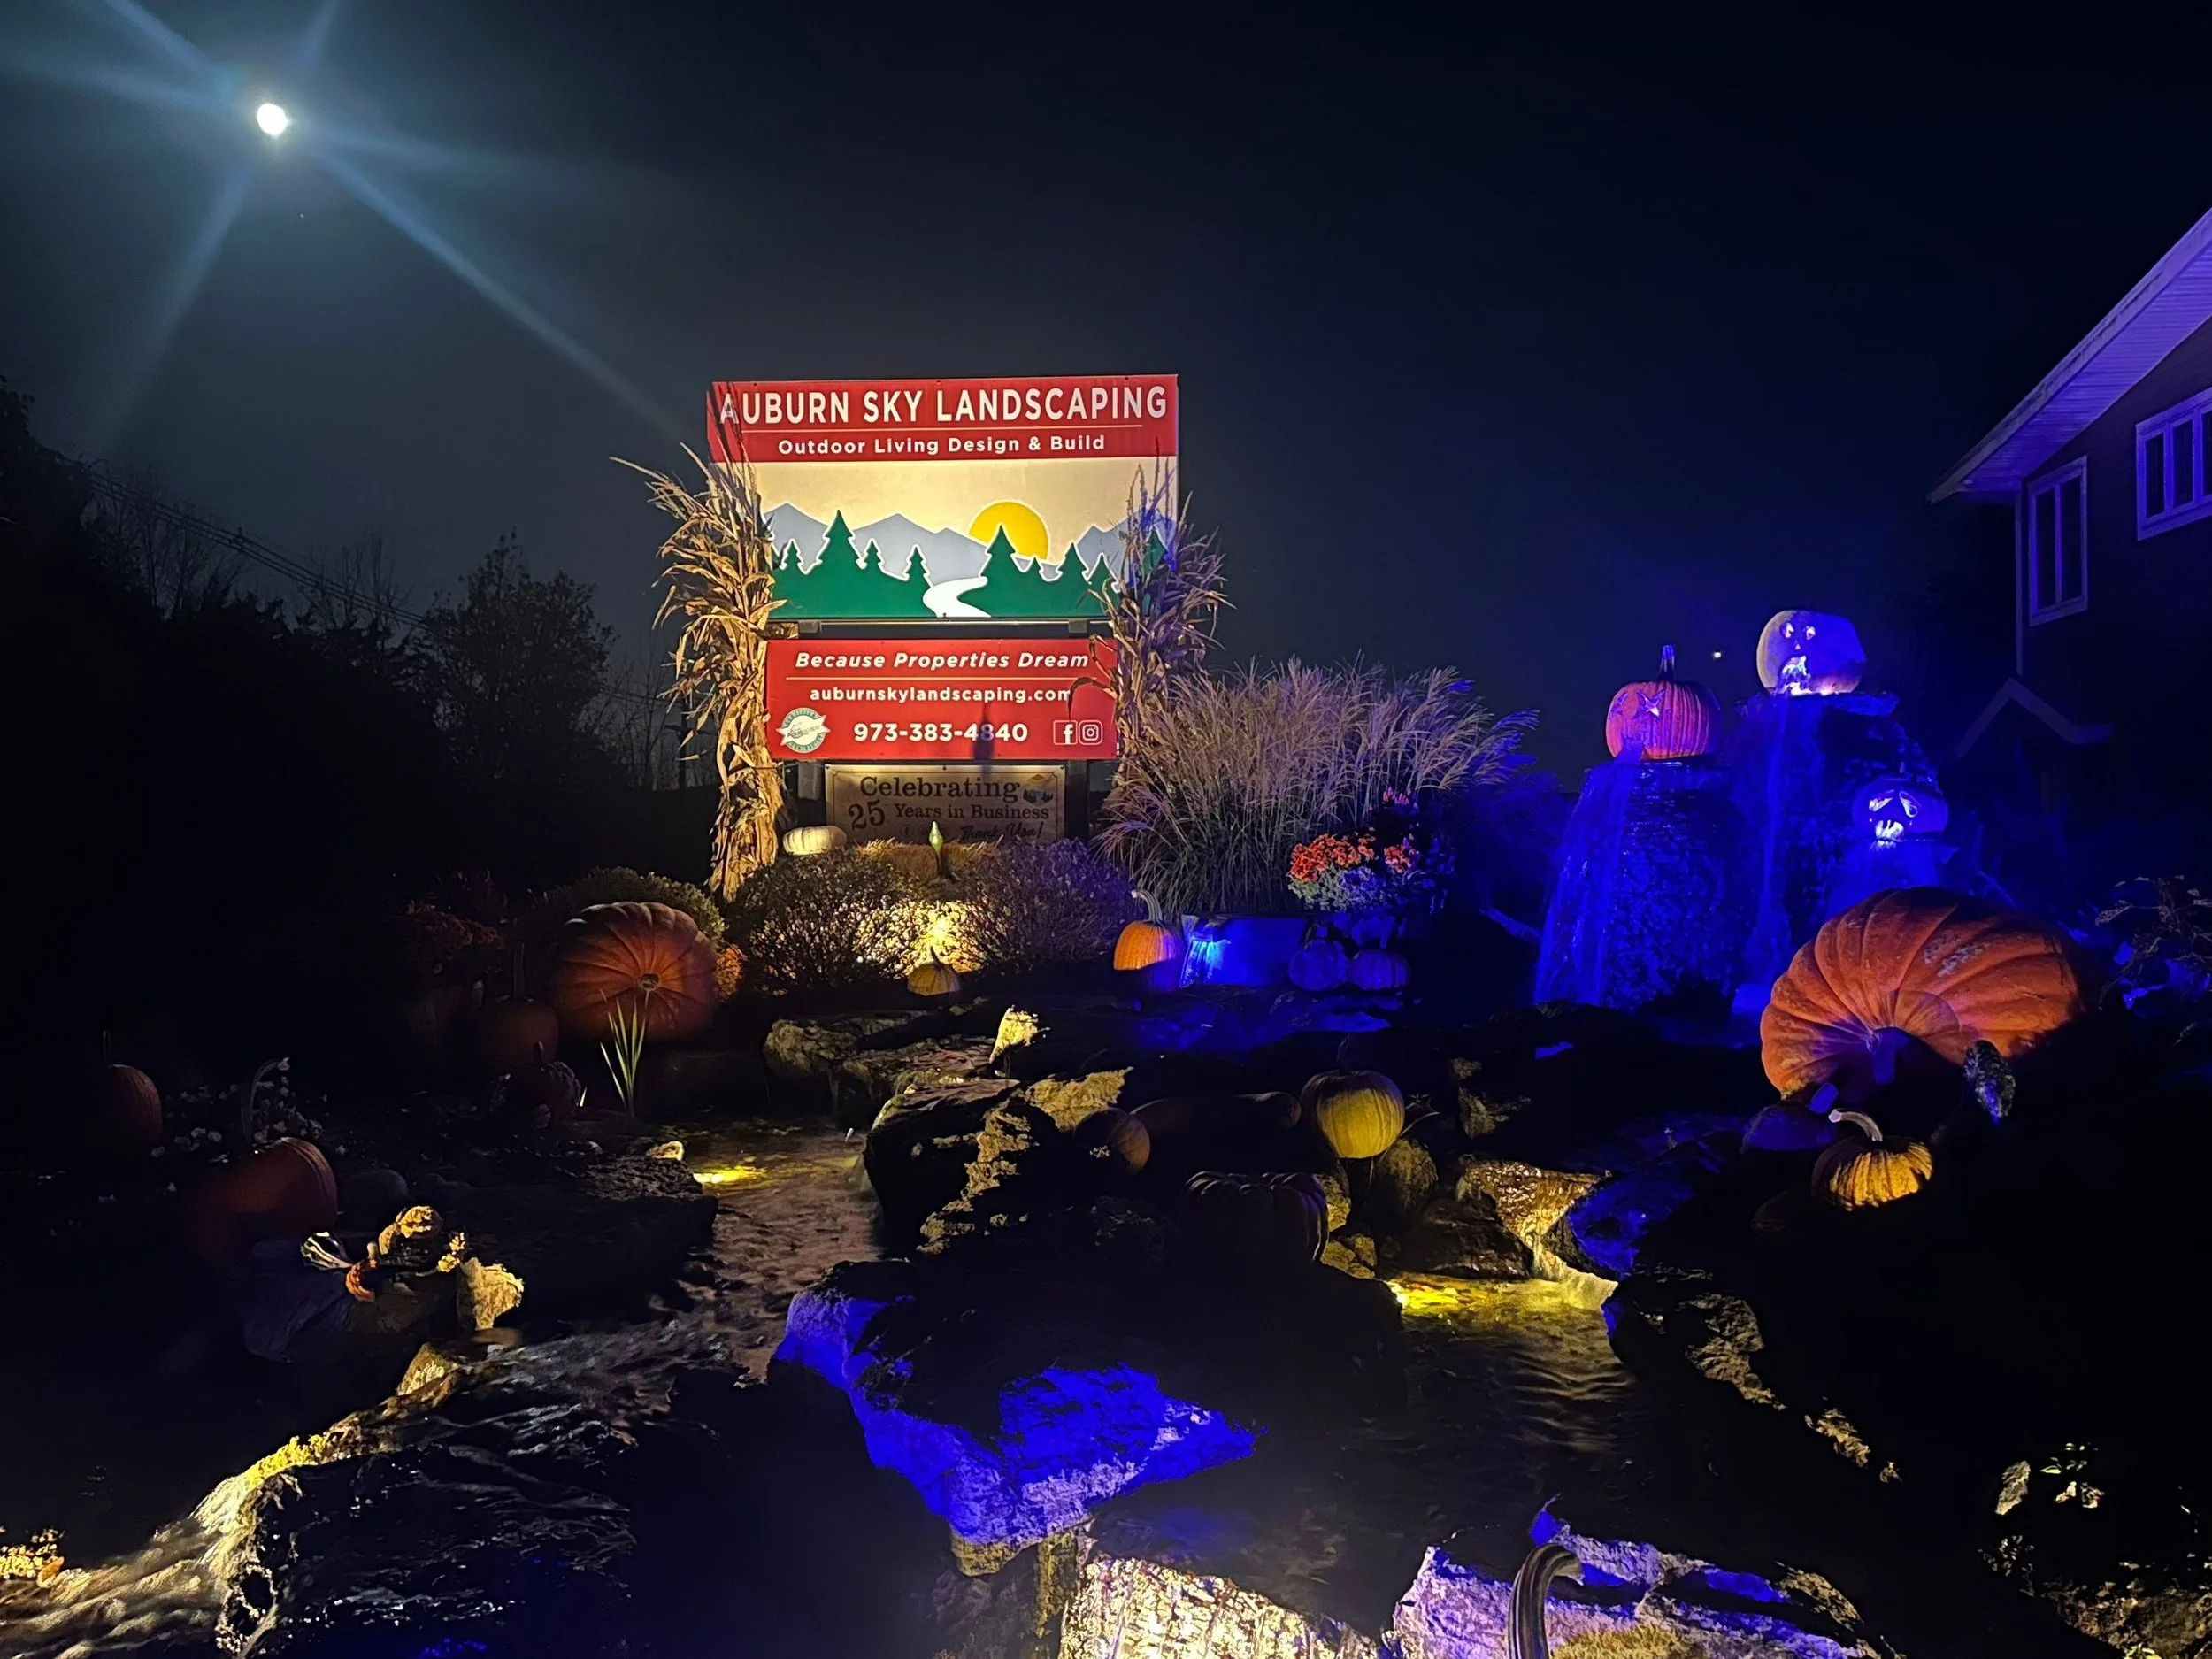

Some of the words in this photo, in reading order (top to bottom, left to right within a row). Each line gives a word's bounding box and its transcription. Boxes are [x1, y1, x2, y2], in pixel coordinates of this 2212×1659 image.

[720, 392, 849, 424] AUBURN
[863, 391, 923, 422] SKY
[937, 386, 1167, 421] LANDSCAPING
[778, 439, 866, 454] Outdoor
[874, 438, 939, 455] Living
[948, 437, 1020, 454] Design
[1029, 436, 1041, 450] &
[1050, 435, 1105, 450] Build
[795, 653, 885, 668] Because
[894, 652, 1010, 670] Properties
[1018, 653, 1088, 668] Dream
[810, 687, 1071, 703] auburnskylandscaping.com
[854, 723, 1028, 742] 973-383-4840
[860, 776, 1020, 803] Celebrating
[849, 800, 886, 829] 25
[895, 803, 942, 819] Years
[948, 803, 964, 818] in
[971, 803, 1049, 819] Business
